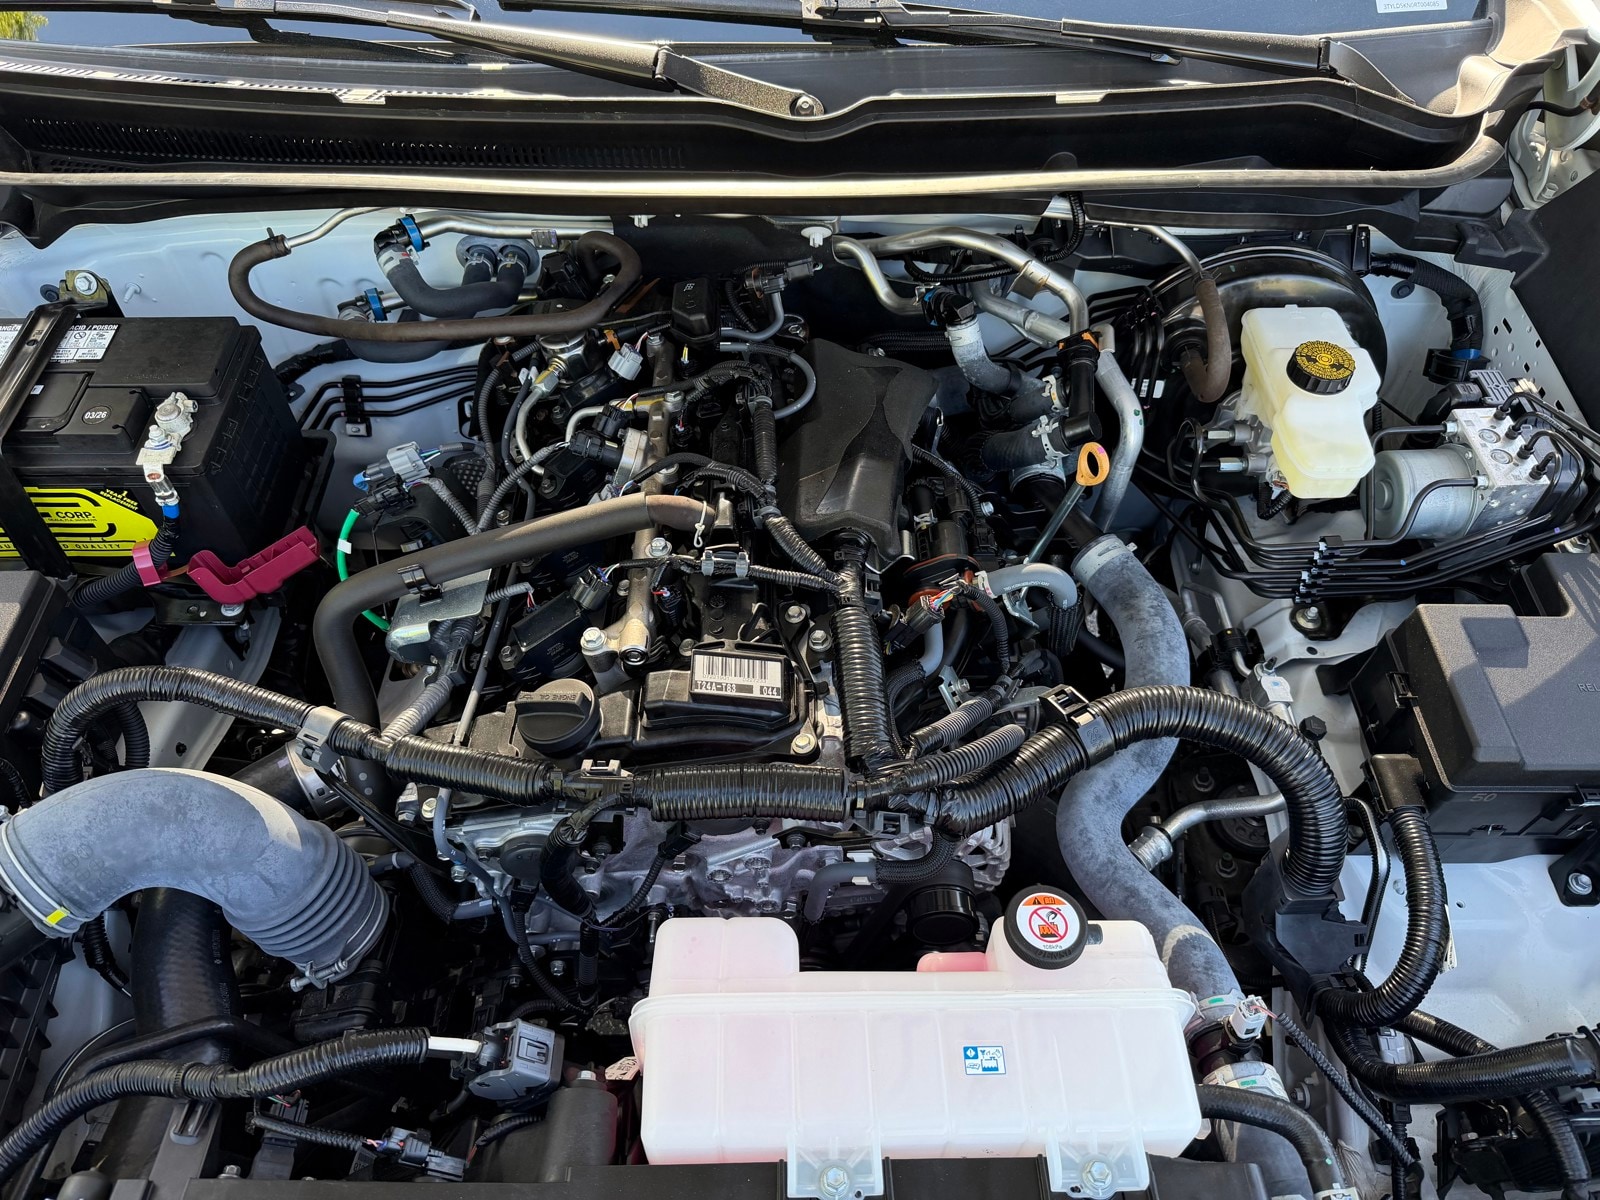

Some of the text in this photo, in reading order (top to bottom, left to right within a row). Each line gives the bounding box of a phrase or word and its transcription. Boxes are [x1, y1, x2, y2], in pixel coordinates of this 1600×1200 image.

[85, 411, 109, 419] 03/26
[100, 490, 139, 511] REPLACEMENT
[105, 488, 138, 506] YEAR FREE
[55, 511, 96, 519] CORP.
[696, 681, 778, 697] T24A-T63 044
[1469, 793, 1498, 802] 50
